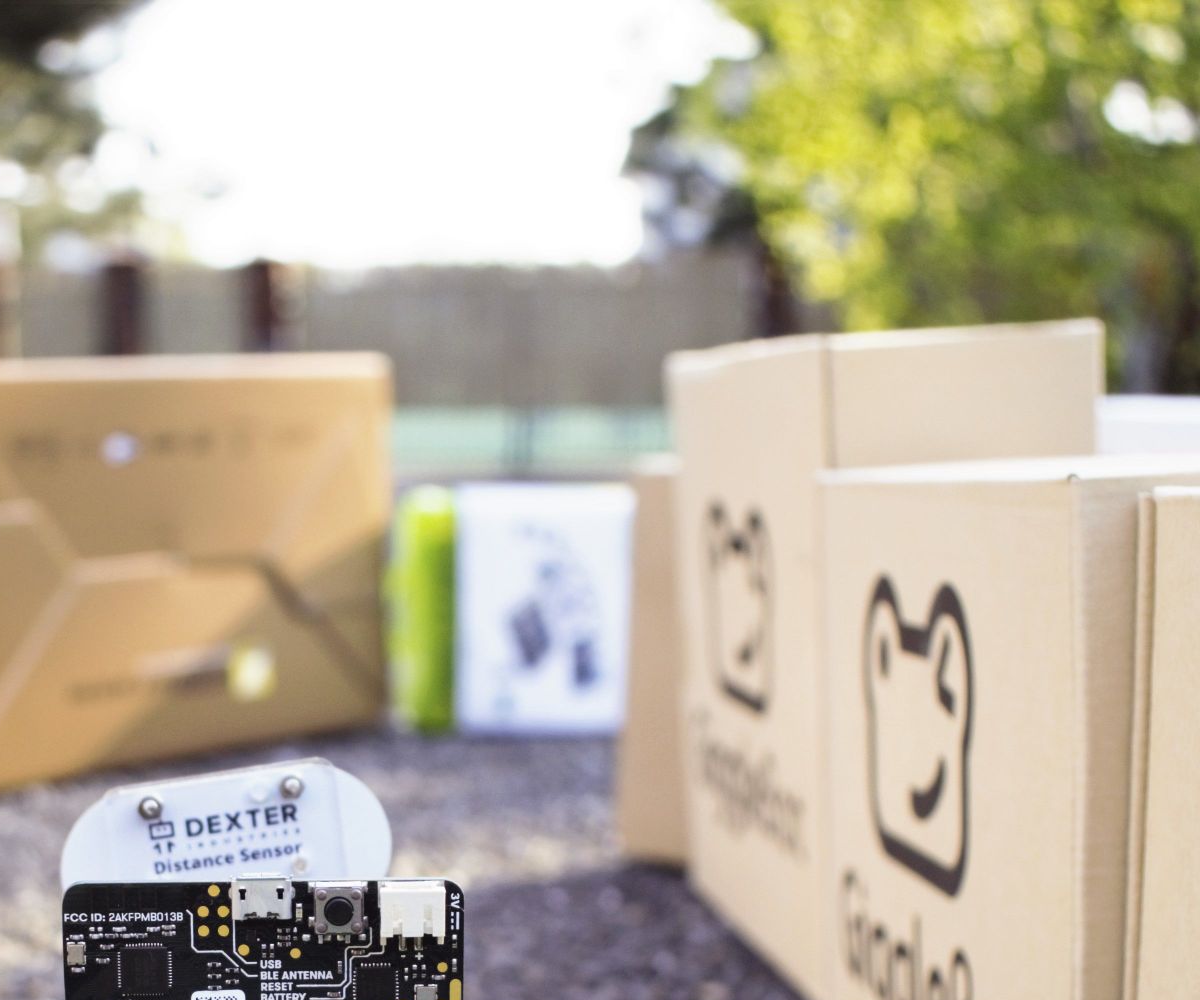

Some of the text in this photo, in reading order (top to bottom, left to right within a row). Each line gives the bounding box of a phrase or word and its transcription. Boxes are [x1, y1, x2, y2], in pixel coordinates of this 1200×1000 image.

[185, 803, 298, 838] DEXTER
[154, 843, 302, 875] Distance Sensor
[450, 892, 461, 909] 3V
[63, 912, 89, 922] FCC
[90, 912, 106, 922] ID:
[260, 959, 282, 969] USB
[260, 970, 334, 980] BLE ANTENNA
[260, 982, 293, 992] RESET
